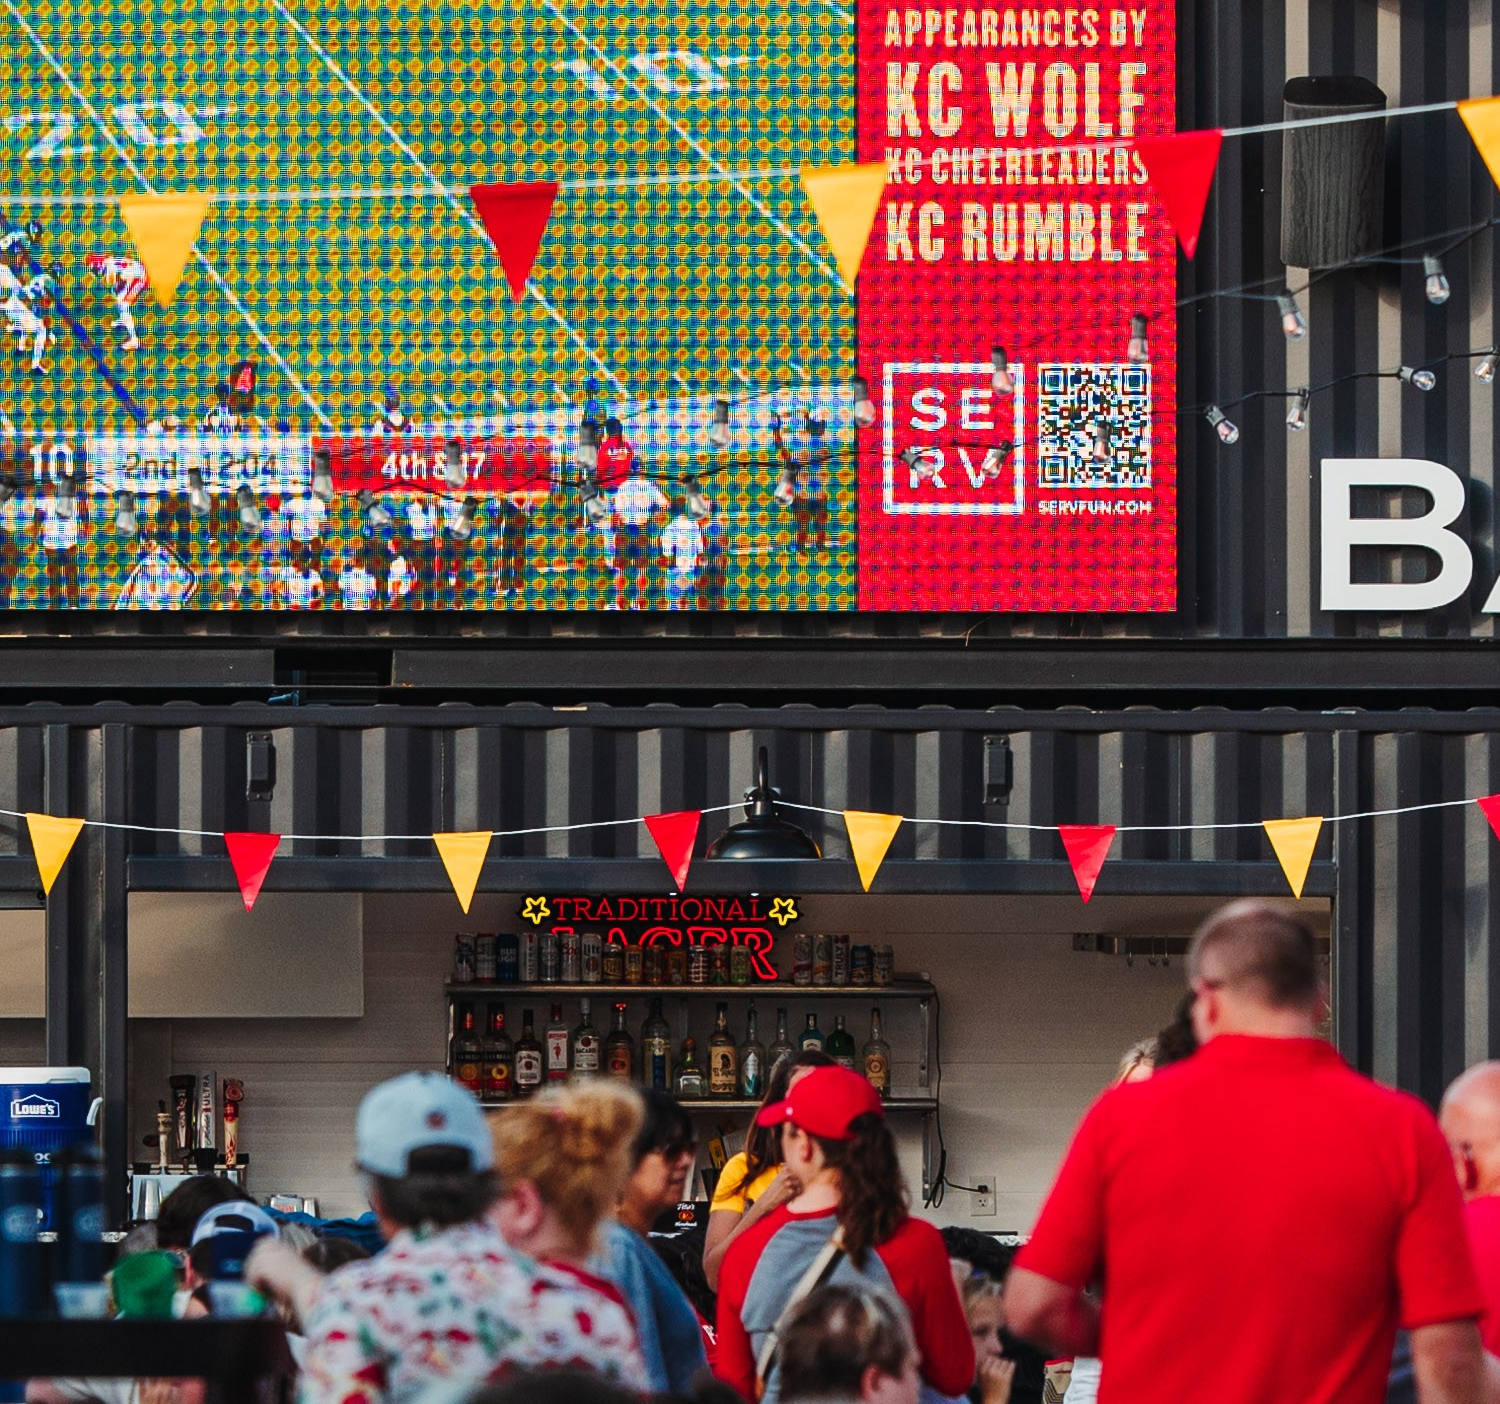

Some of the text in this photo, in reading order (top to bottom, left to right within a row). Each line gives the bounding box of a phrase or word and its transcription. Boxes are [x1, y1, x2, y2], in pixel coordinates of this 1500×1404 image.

[884, 8, 1148, 48] APPEARANCES BY
[886, 61, 1149, 137] KC WOLF
[886, 148, 1149, 185] KC CHEERLEADERS
[886, 201, 1149, 262] KC RUMBLE
[911, 388, 996, 430] SE
[31, 442, 74, 482] 10
[125, 452, 177, 480] 2nd
[382, 452, 430, 481] 4th
[1038, 500, 1152, 514] SERVFUN.COM
[552, 898, 767, 922] TRADITIONAL
[834, 946, 845, 978] TRULY
[15, 1102, 55, 1115] LOWE'S
[202, 1074, 211, 1109] ULTRA
